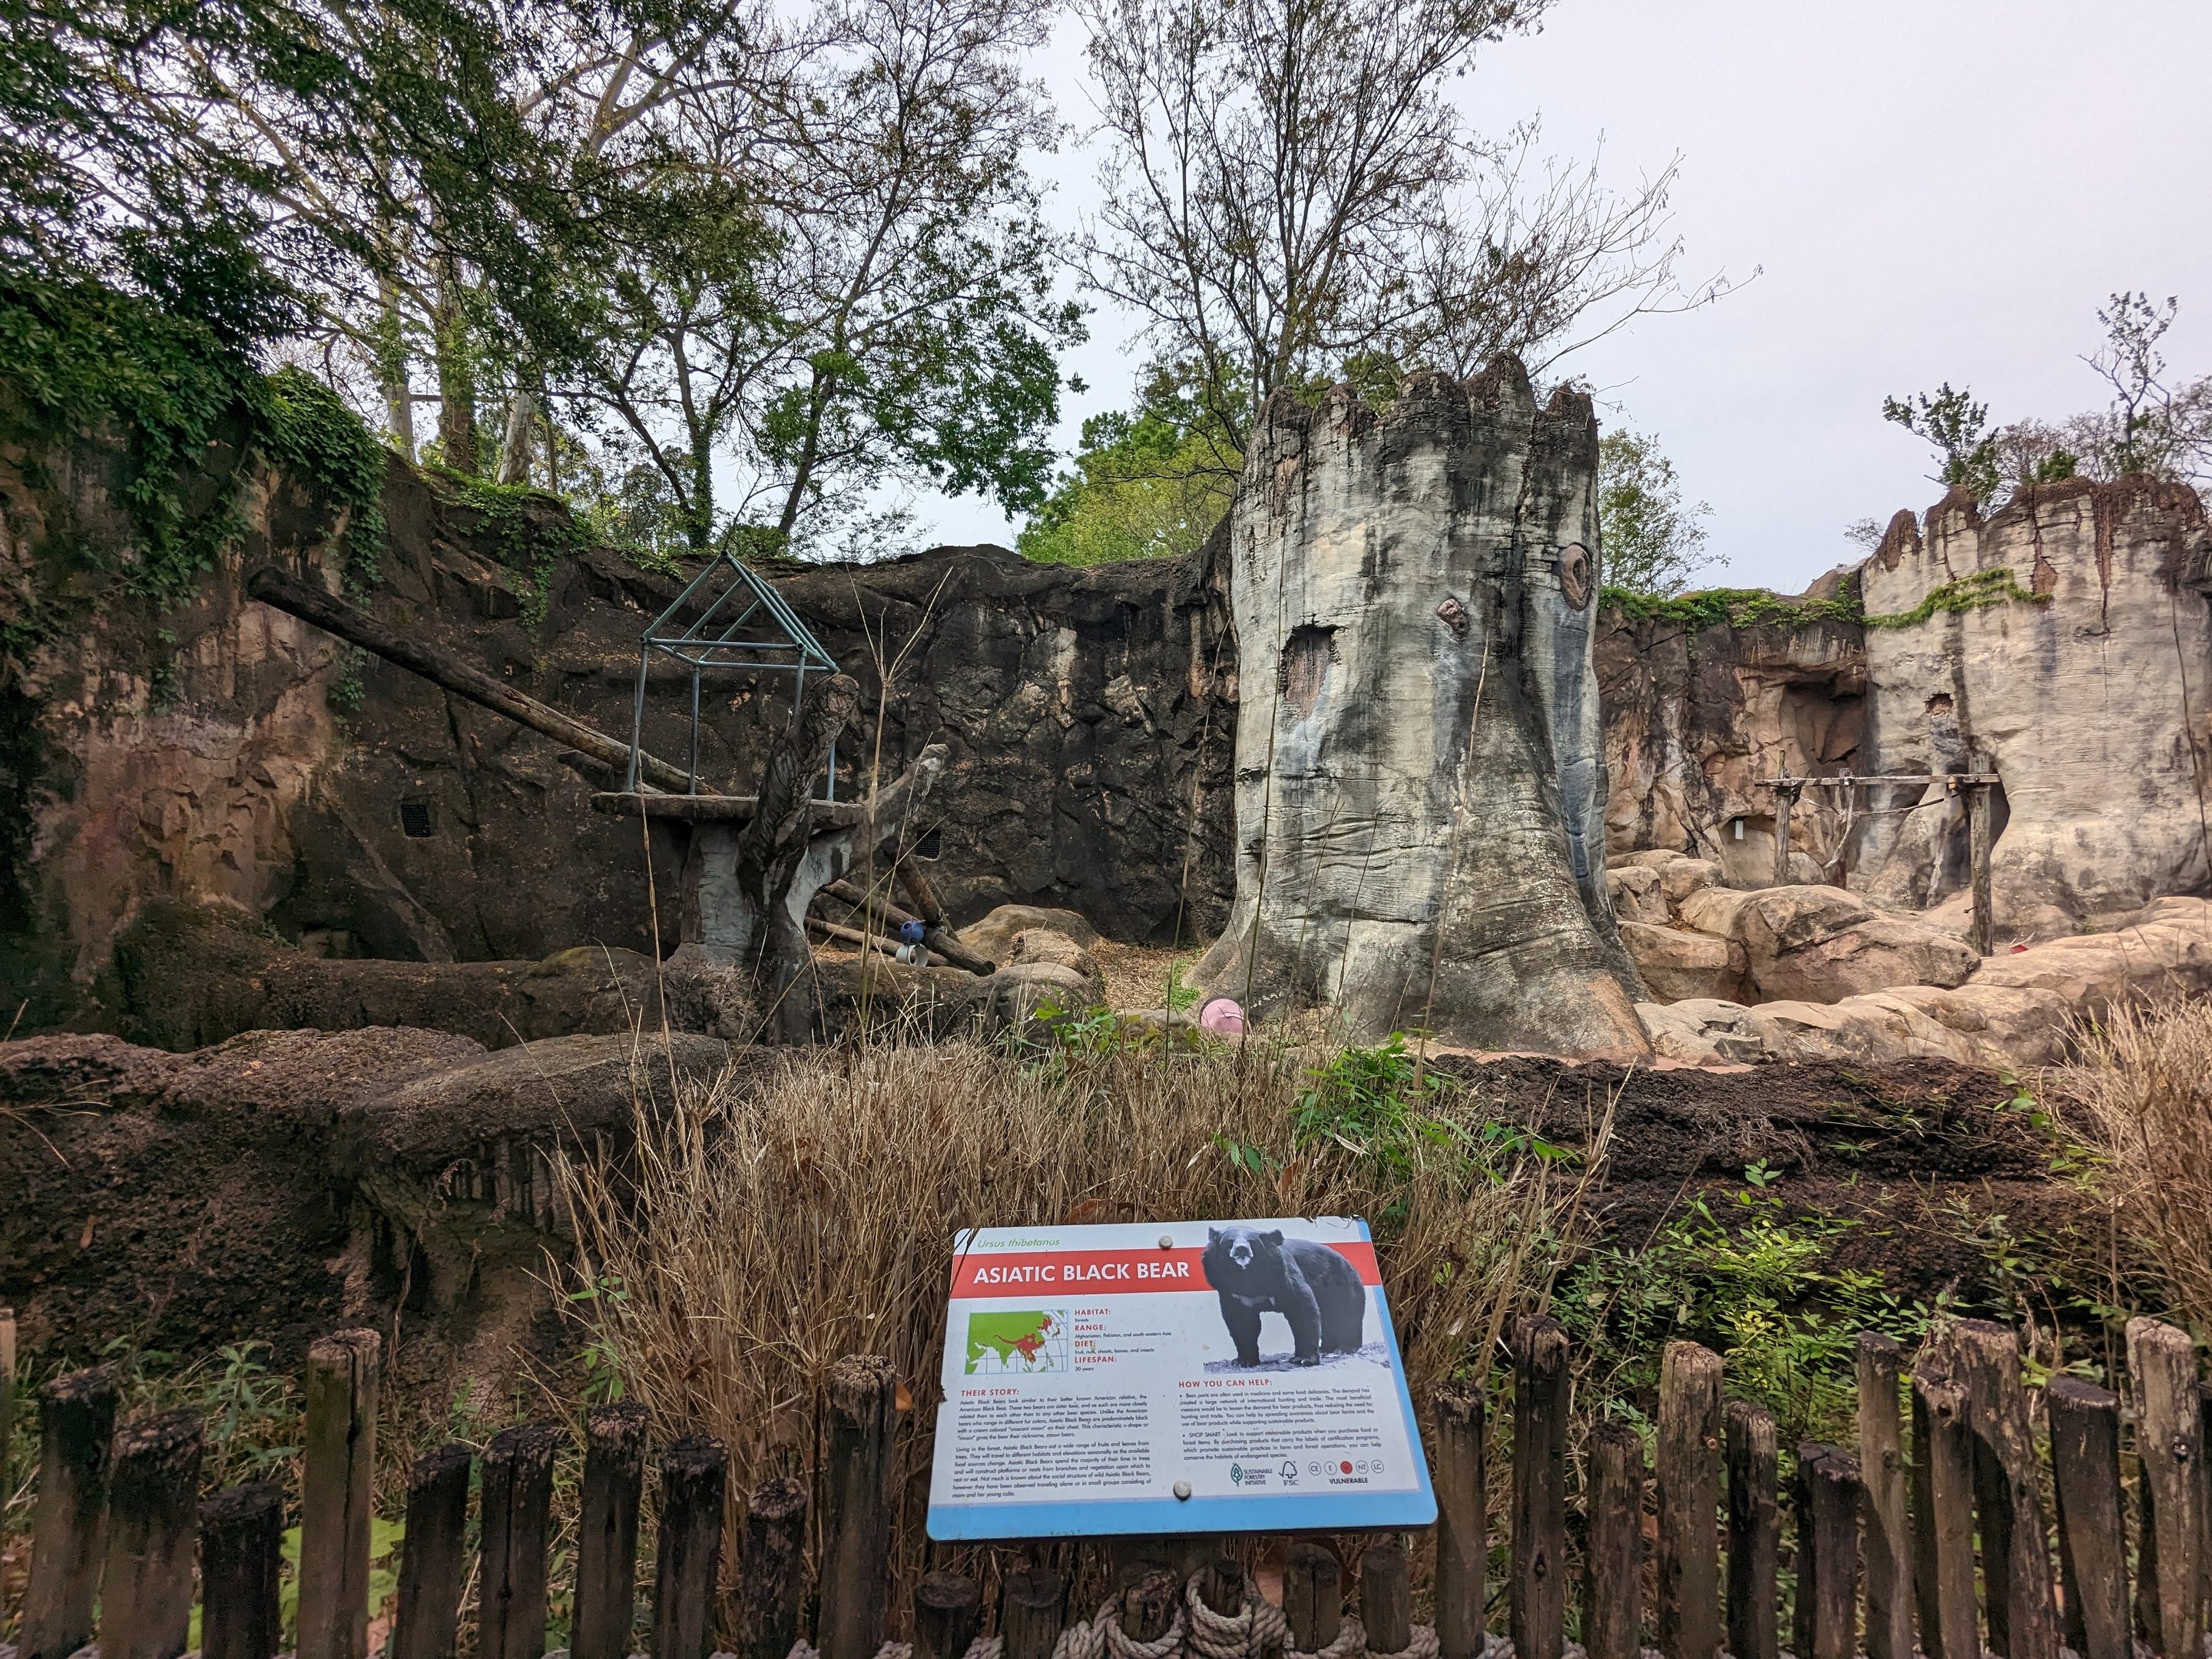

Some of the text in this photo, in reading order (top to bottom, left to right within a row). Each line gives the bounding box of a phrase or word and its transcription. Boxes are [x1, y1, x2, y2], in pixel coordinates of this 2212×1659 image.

[973, 1262, 1189, 1284] ASIATIC BLACK BEAR
